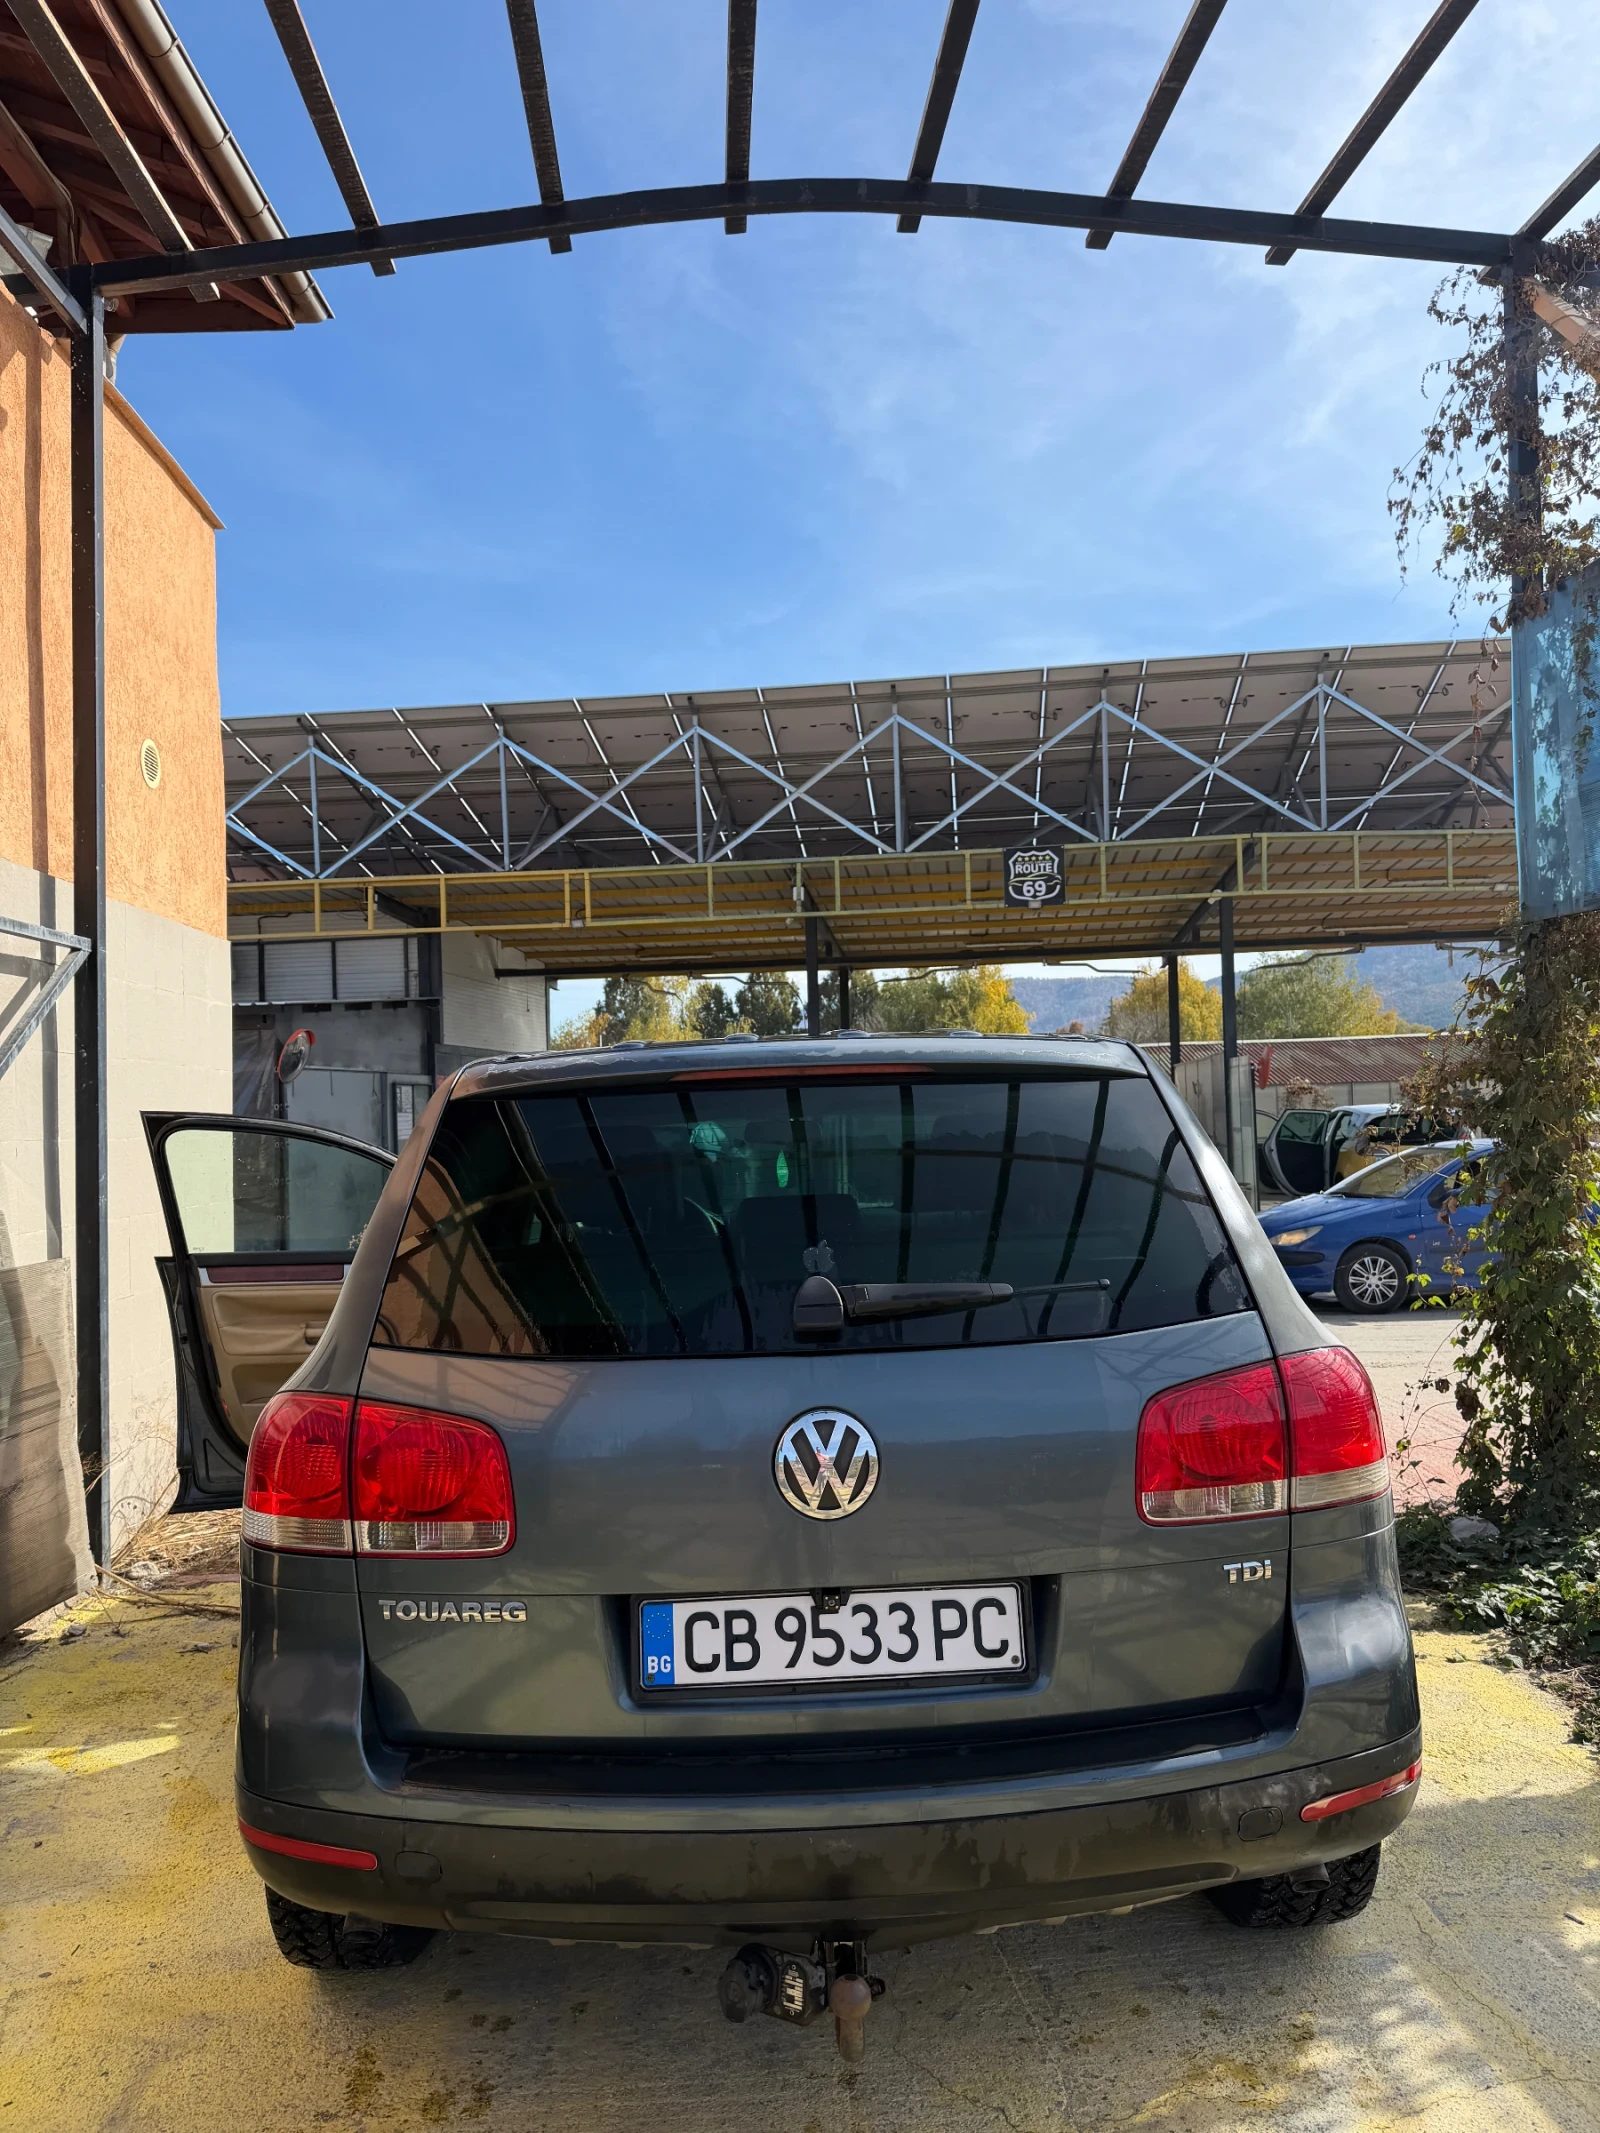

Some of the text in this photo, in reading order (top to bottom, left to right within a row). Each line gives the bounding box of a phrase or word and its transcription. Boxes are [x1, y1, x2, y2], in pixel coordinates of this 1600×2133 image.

[1015, 863, 1053, 874] ROUTE
[1022, 880, 1047, 897] 69
[1223, 1559, 1272, 1584] TDI
[378, 1599, 527, 1623] TOUAREG
[684, 1597, 1010, 1673] CB 9533 PC
[647, 1655, 671, 1674] BG
